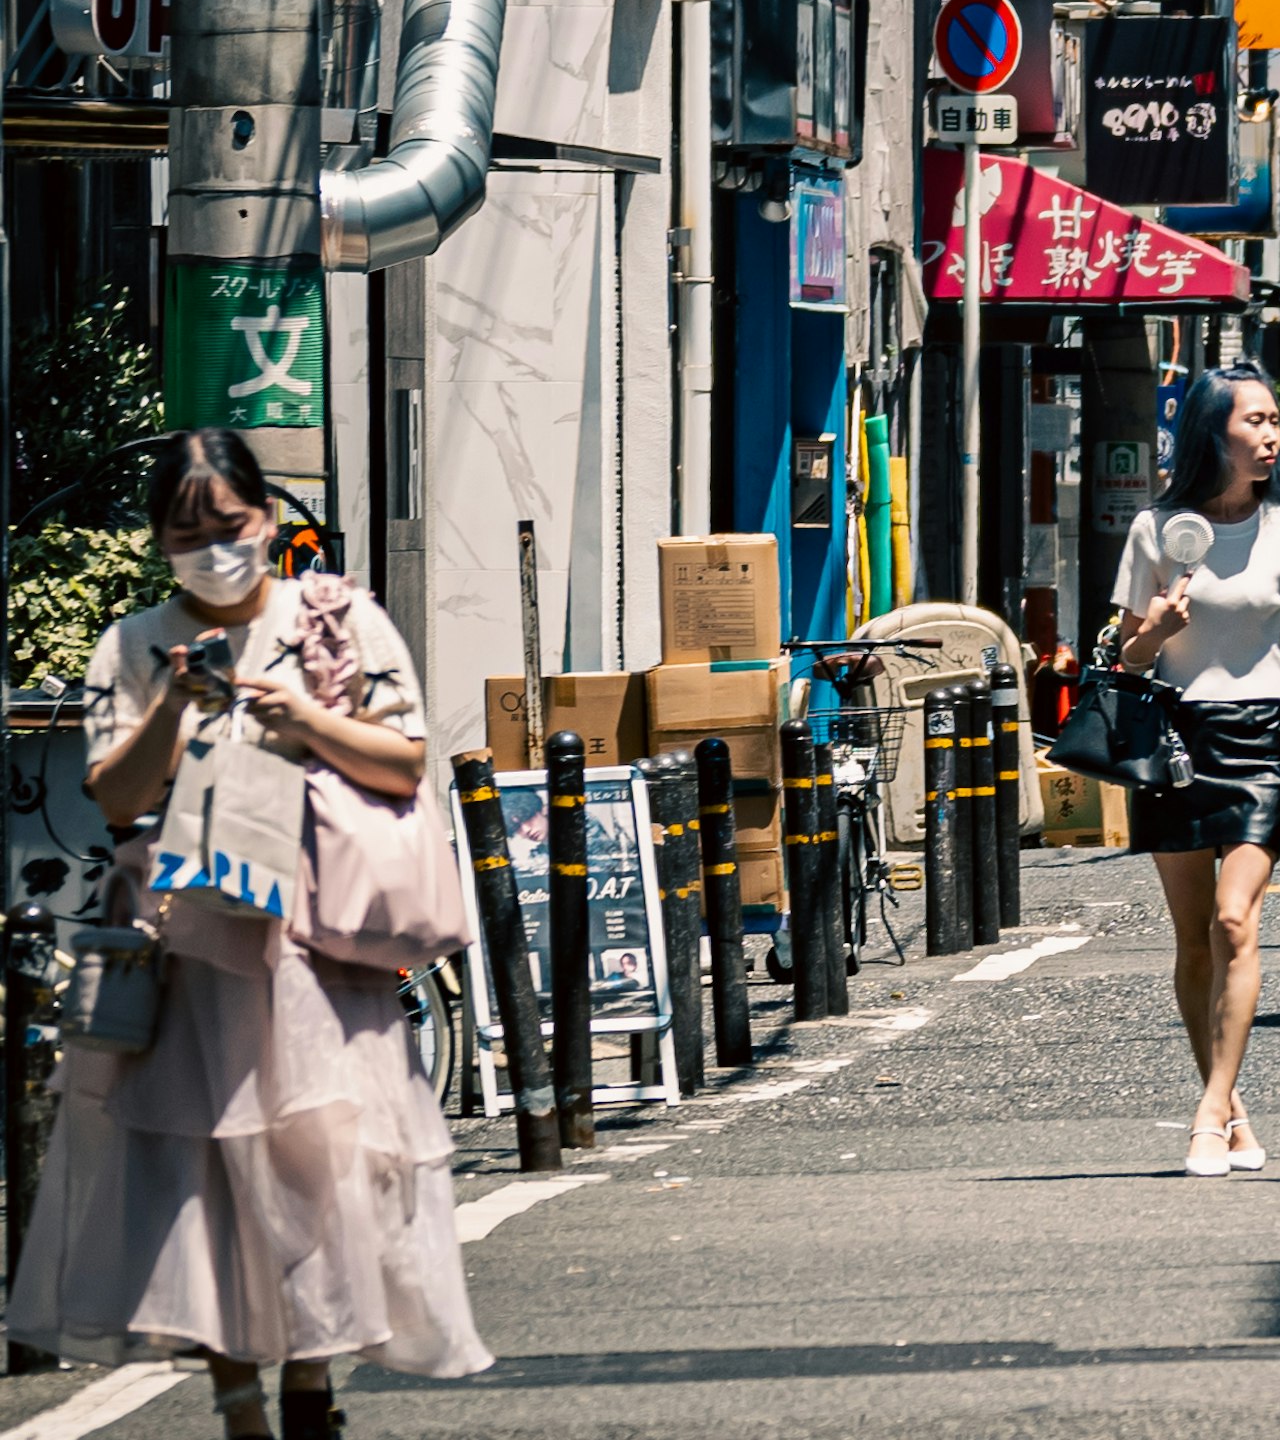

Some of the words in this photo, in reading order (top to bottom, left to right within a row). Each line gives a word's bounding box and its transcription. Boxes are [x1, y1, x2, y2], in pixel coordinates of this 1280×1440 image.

[940, 105, 1013, 133] 自動車
[210, 275, 319, 299] スクールゾーン
[227, 303, 313, 399] 文
